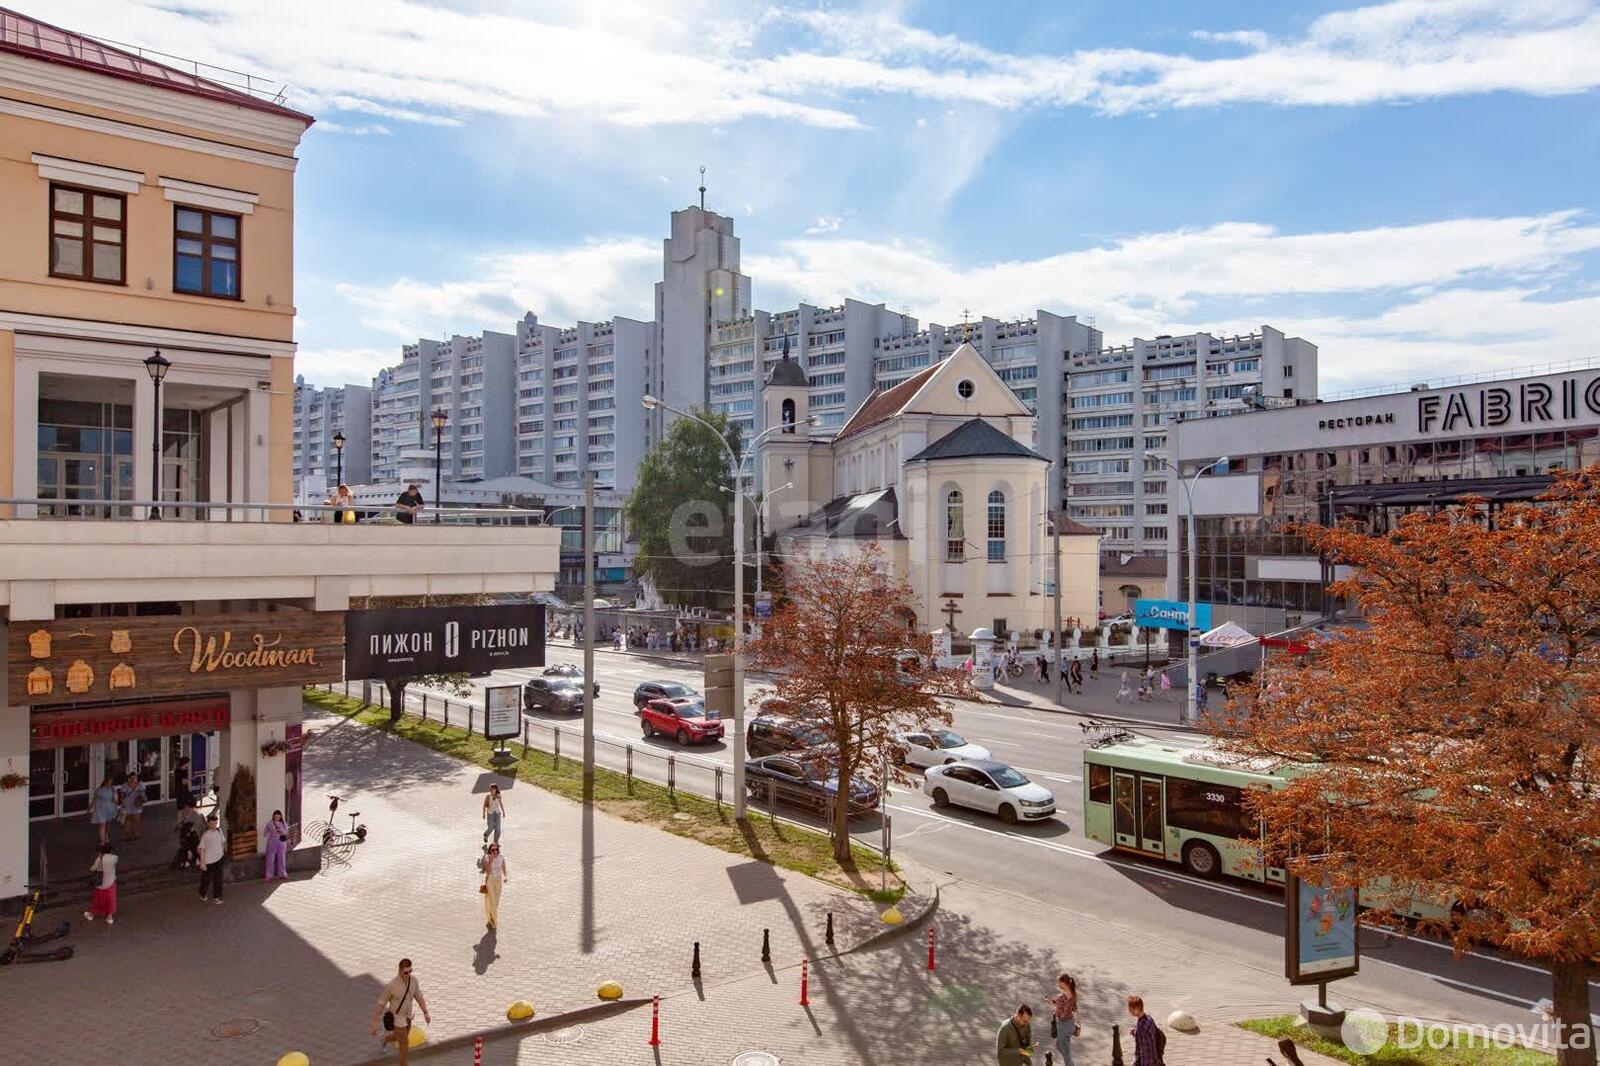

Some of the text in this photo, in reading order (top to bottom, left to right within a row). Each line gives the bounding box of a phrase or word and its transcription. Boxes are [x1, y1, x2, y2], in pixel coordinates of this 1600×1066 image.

[1318, 412, 1395, 431] РЕСТОРАН
[370, 632, 433, 655] ПИЖОН
[471, 627, 529, 649] PIZHON
[173, 626, 319, 673] Woodman
[1206, 792, 1225, 803] 3330
